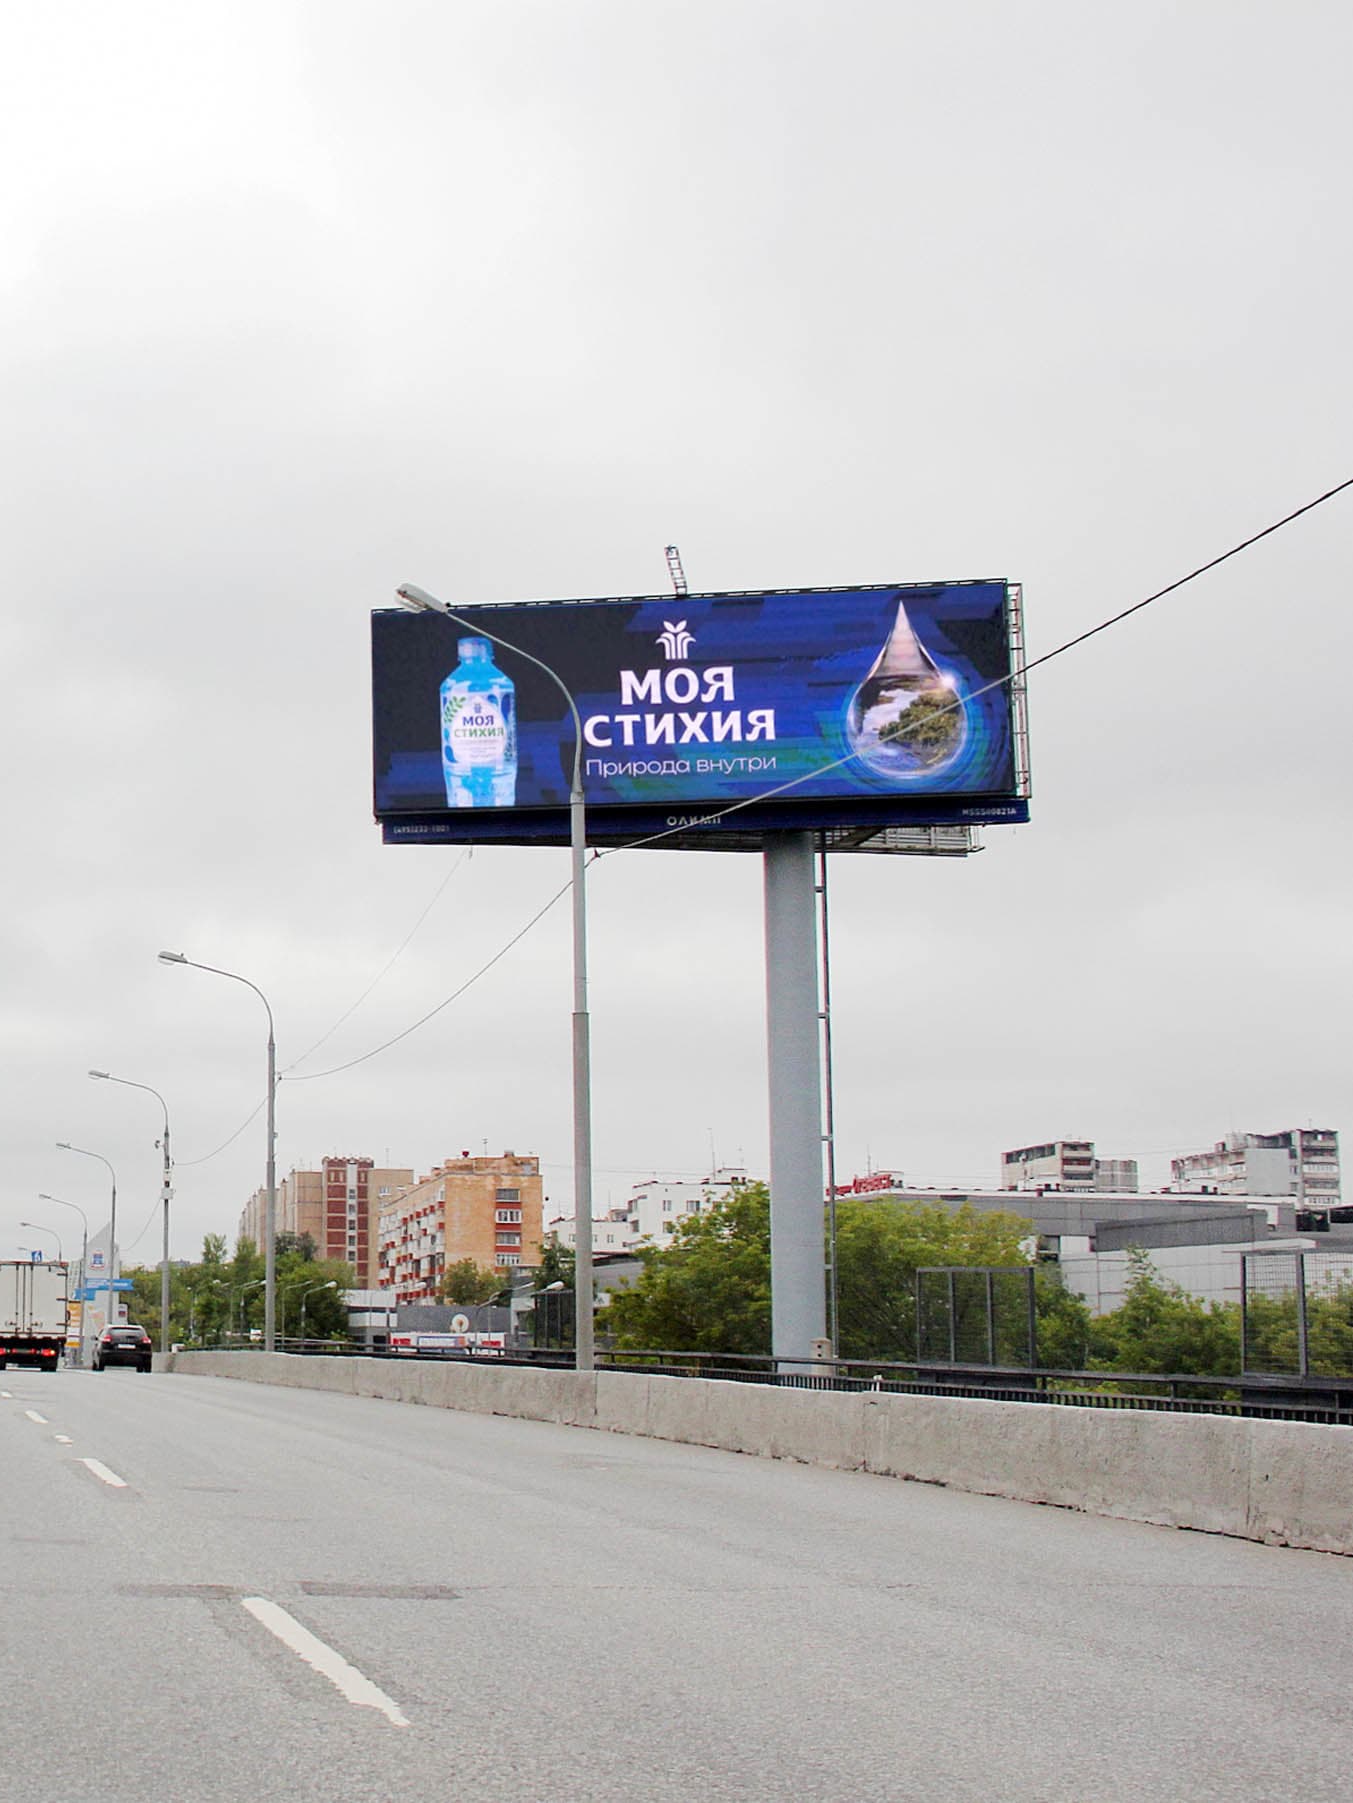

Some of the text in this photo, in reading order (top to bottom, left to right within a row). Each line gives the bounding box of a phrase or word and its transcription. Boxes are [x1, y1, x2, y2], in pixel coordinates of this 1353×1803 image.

[620, 666, 735, 706] МОЯ
[462, 715, 494, 726] МОЯ
[583, 709, 776, 748] СТИХИЯ
[454, 727, 504, 738] СТИХИЯ
[586, 756, 777, 778] Природа внутри
